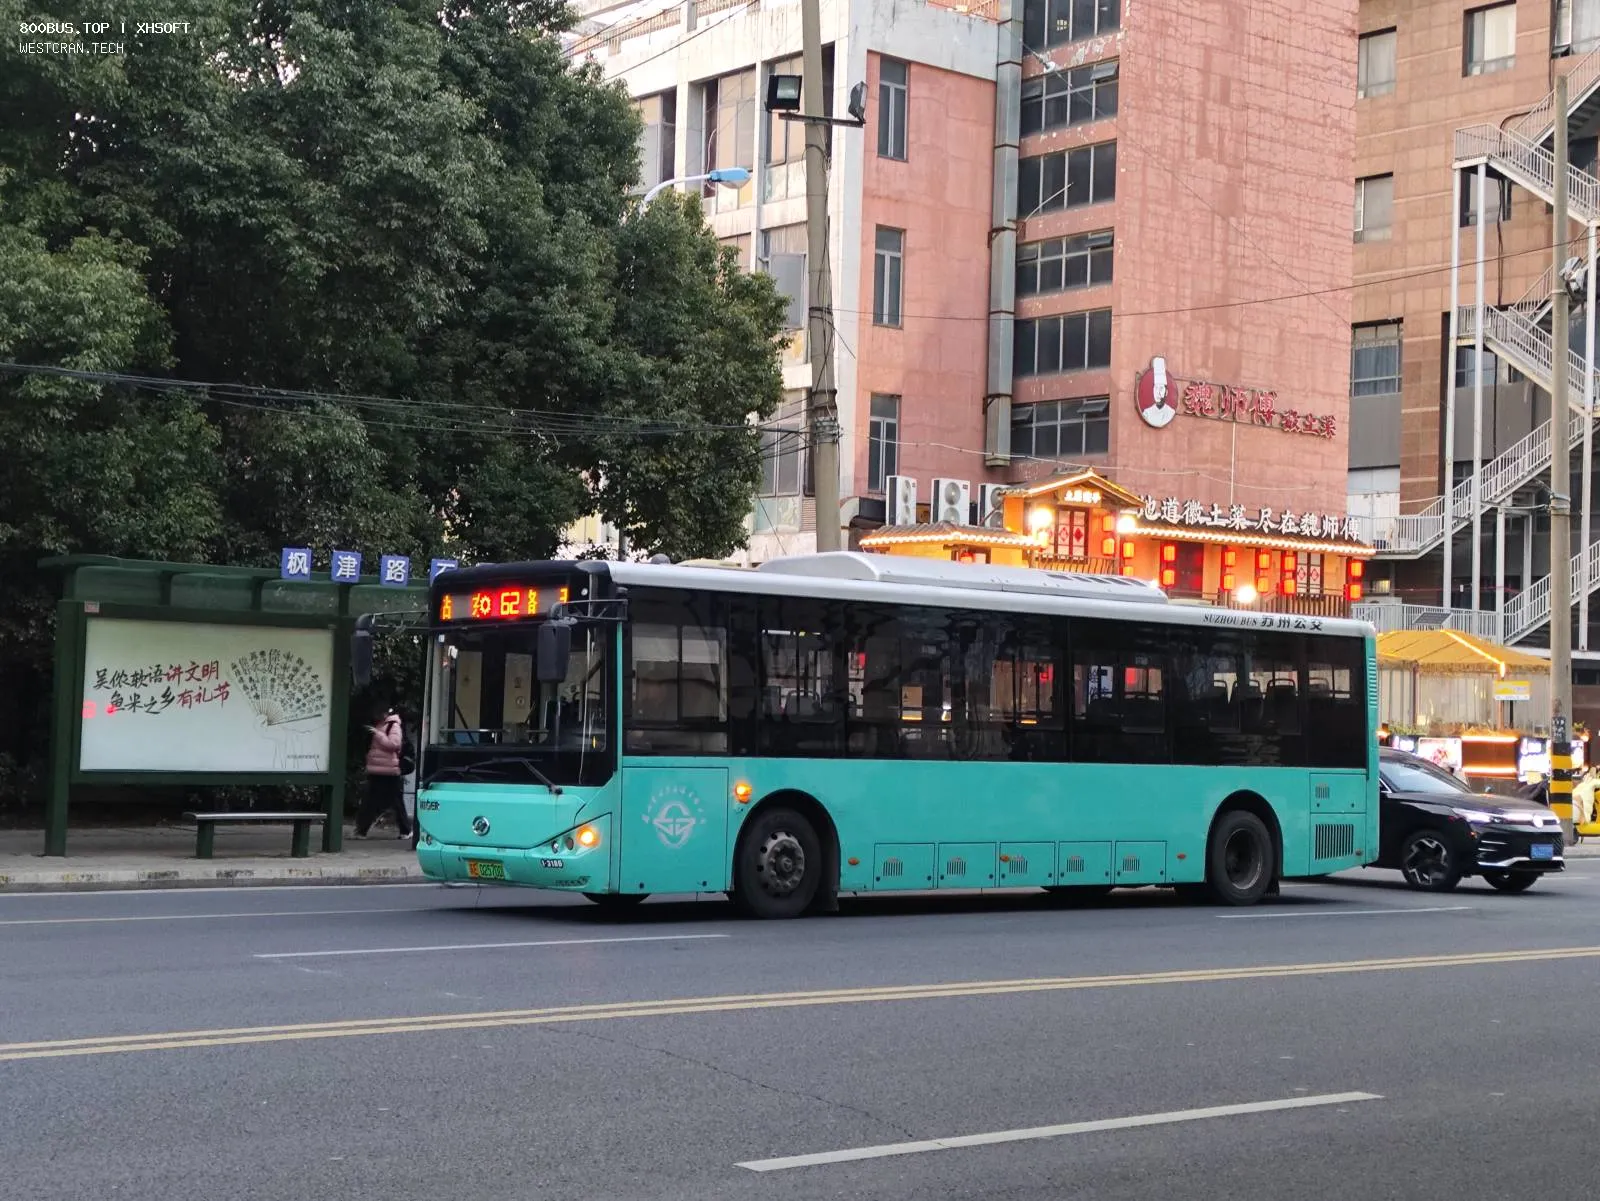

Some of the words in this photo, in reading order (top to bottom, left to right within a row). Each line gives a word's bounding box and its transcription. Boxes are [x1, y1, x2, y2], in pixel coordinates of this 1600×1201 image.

[1256, 507, 1361, 542] 尽在魏师傅
[1203, 613, 1239, 626] SUZHOU
[1240, 616, 1258, 627] BUS
[1260, 614, 1324, 632] 苏州公交
[93, 660, 220, 689] 吴侬软语讲文明
[107, 681, 230, 714] 鱼米之乡有礼节
